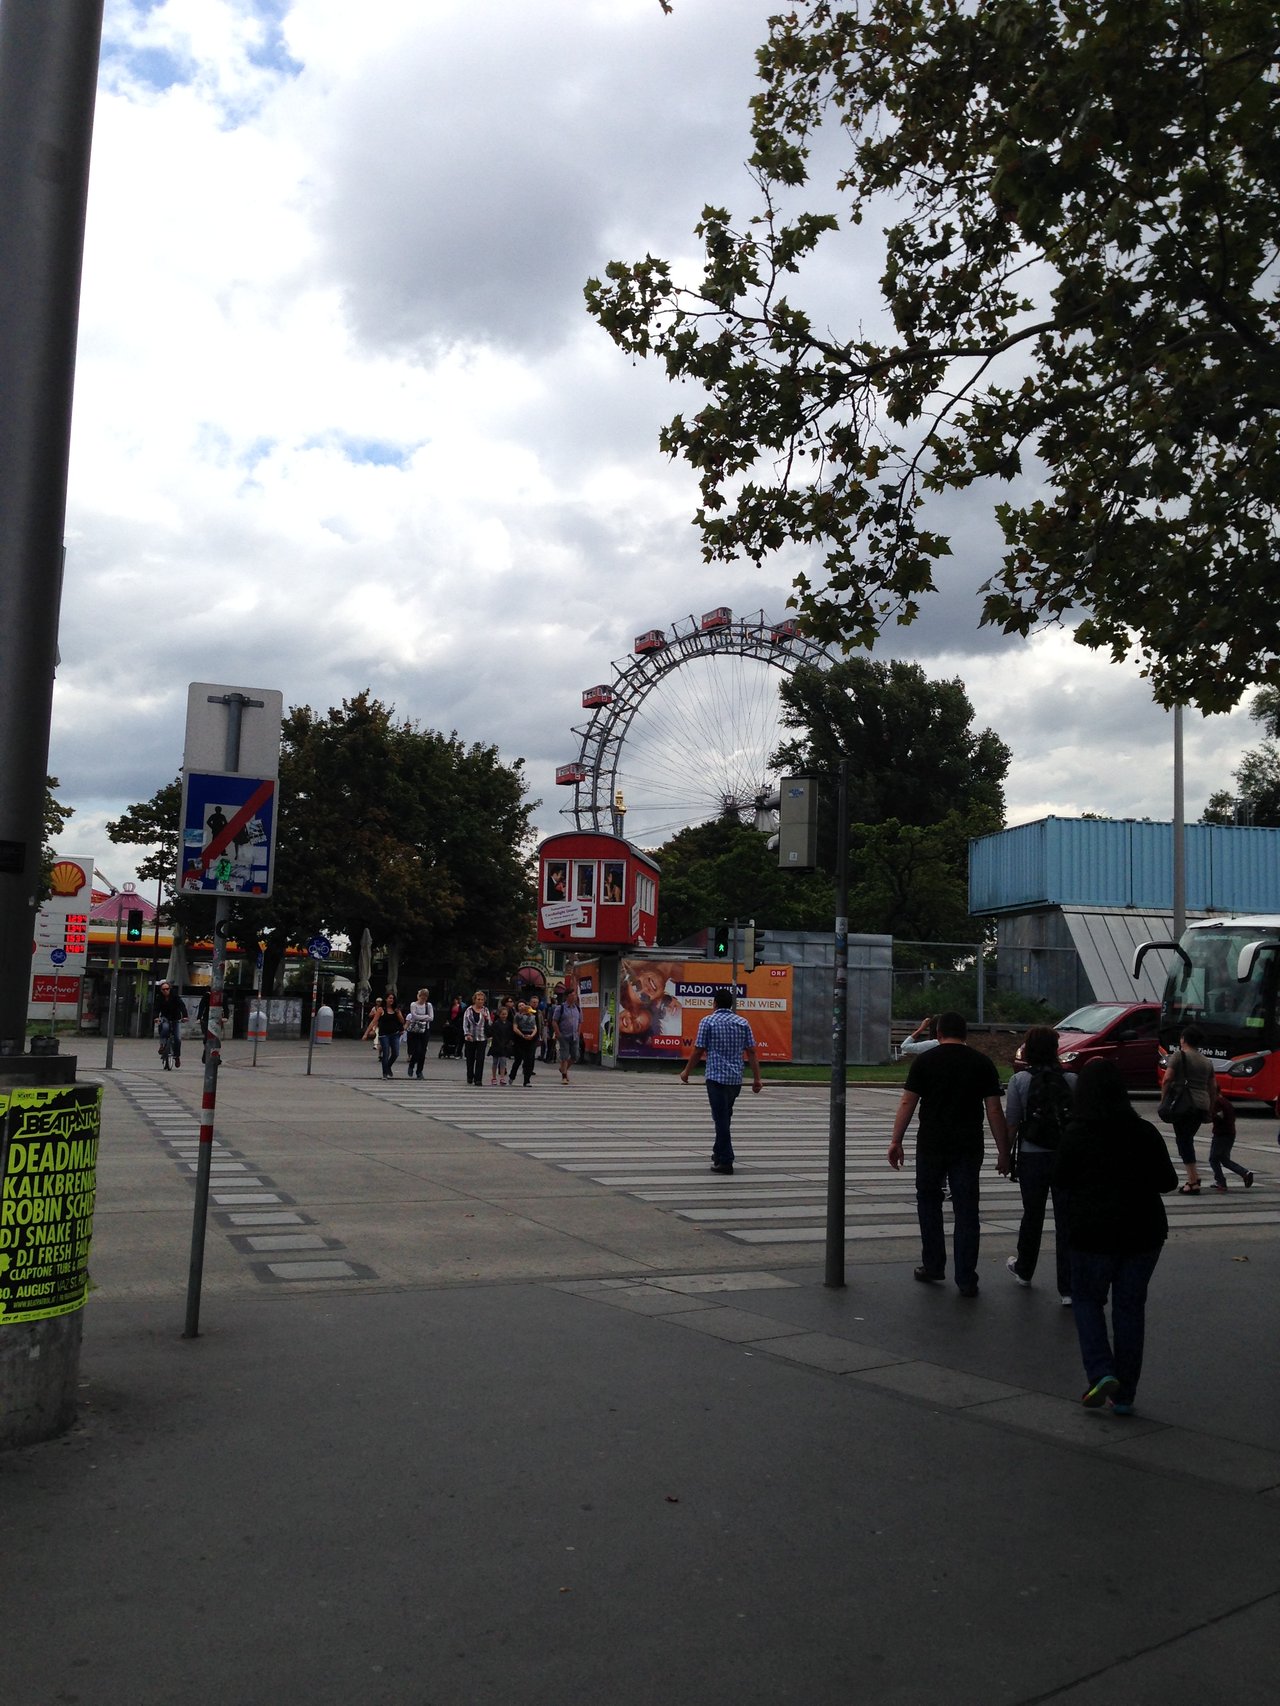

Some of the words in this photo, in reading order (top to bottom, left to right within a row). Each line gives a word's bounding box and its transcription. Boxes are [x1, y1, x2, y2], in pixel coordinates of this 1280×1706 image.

[679, 984, 713, 994] RADIO
[684, 998, 707, 1006] MEIN
[708, 999, 745, 1007] SER
[747, 1000, 756, 1008] IN
[654, 1038, 680, 1046] RADIO
[1214, 1048, 1227, 1057] hat
[1, 1196, 63, 1226] ROBIN
[0, 1227, 20, 1249] DJ
[25, 1221, 72, 1247] SNAKE
[16, 1248, 34, 1268] DJ
[37, 1242, 72, 1265] FRESH
[9, 1264, 53, 1281] CLAPTONE
[16, 1281, 56, 1299] AUGUST
